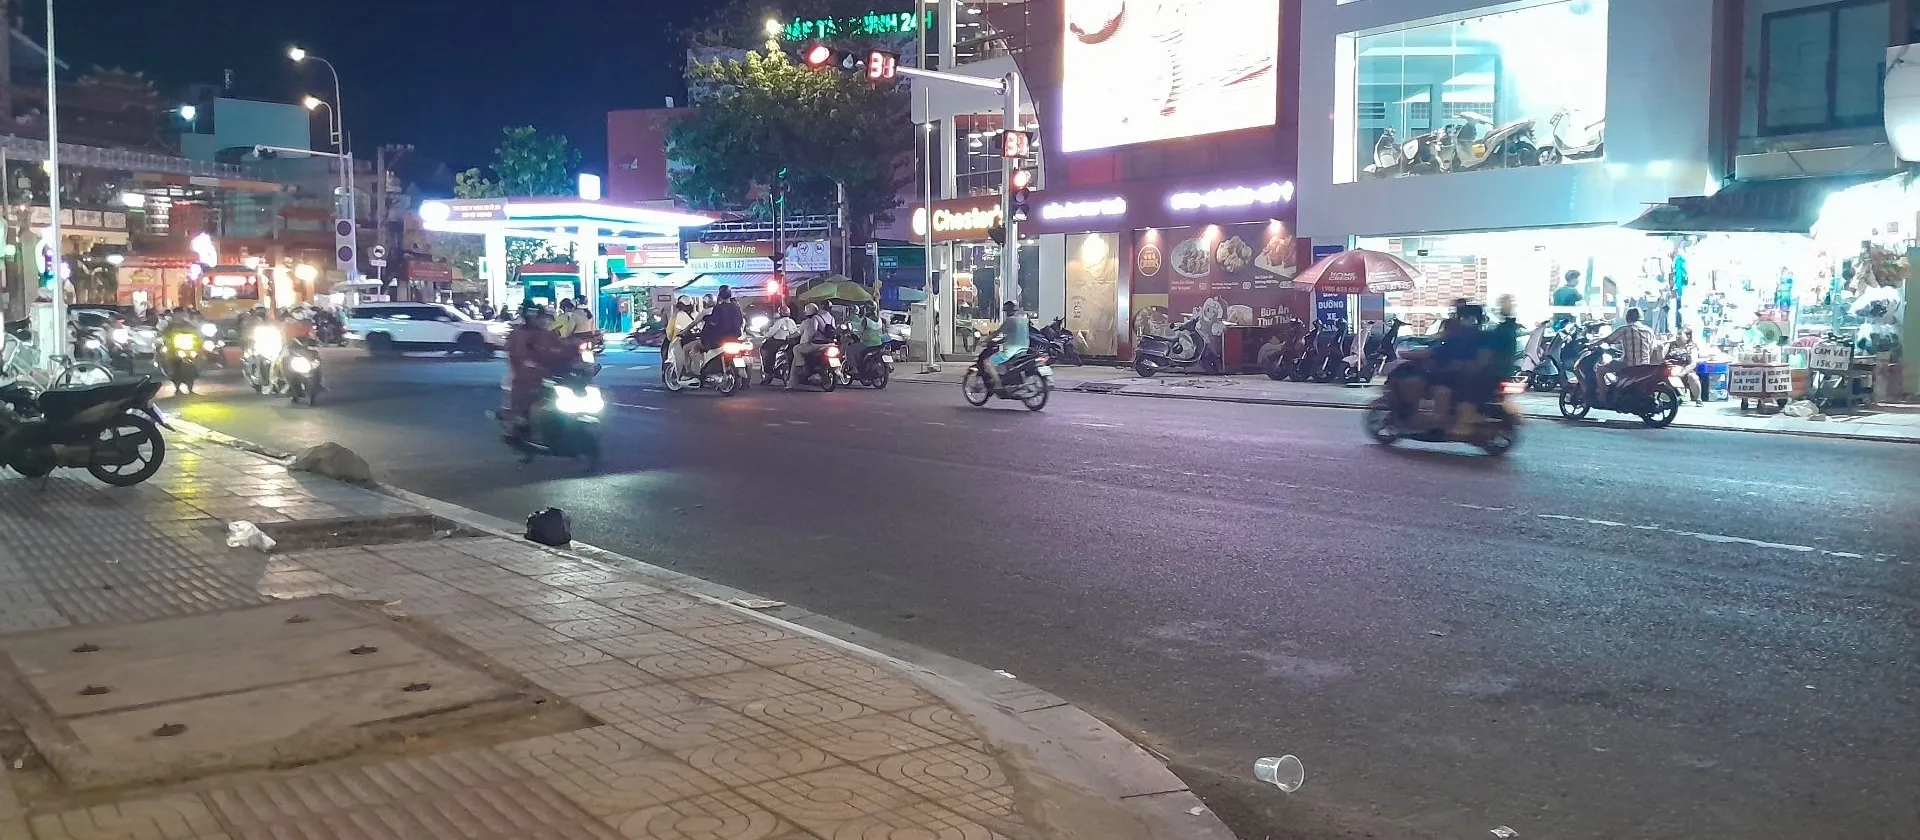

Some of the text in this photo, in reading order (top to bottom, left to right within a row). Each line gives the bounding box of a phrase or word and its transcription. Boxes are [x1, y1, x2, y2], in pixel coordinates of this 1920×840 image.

[722, 245, 756, 255] Havoline
[734, 259, 745, 269] 127
[1326, 312, 1337, 320] XE
[1814, 347, 1831, 356] CAM
